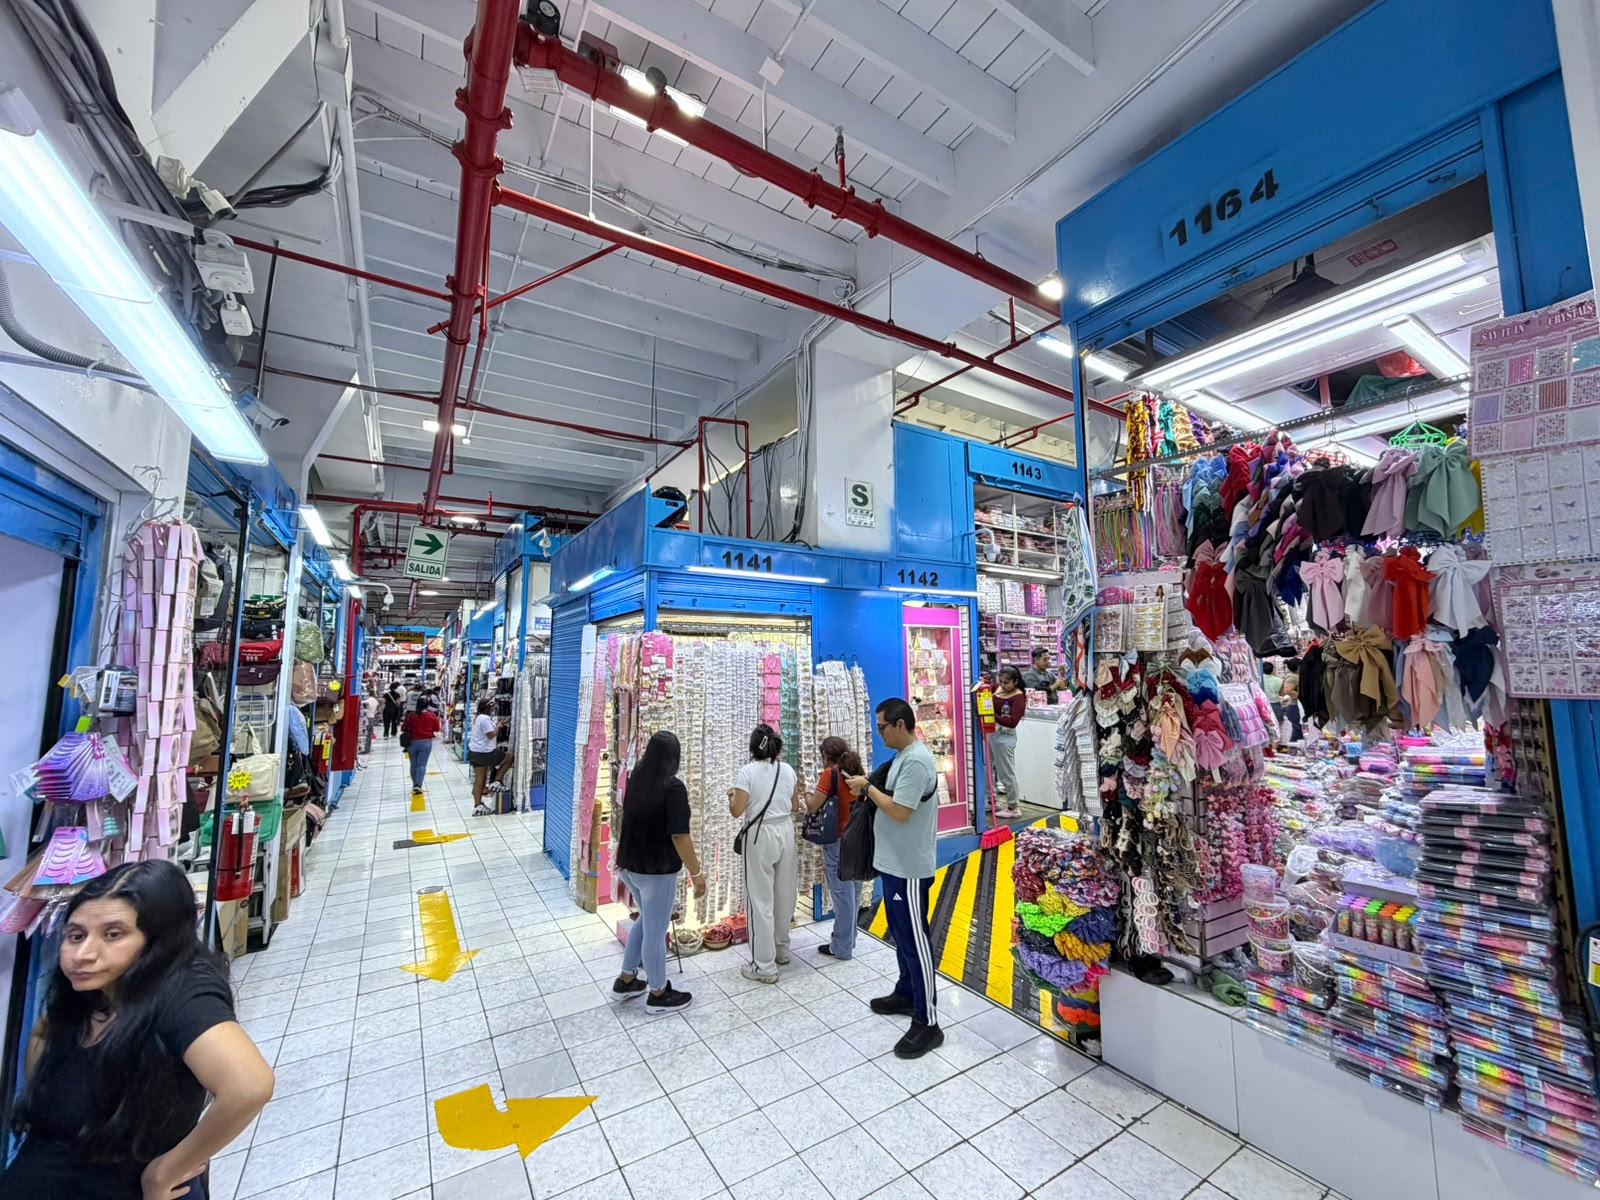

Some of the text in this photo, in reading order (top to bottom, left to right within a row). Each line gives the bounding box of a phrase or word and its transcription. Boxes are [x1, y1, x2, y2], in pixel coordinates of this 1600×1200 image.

[1169, 168, 1279, 246] 1164
[1481, 303, 1594, 341] SAY IT IN CRYSTALS
[1011, 461, 1042, 480] 1143
[851, 484, 869, 507] S
[408, 562, 441, 576] SALIDA
[722, 551, 772, 573] 1141
[897, 569, 939, 587] 1142
